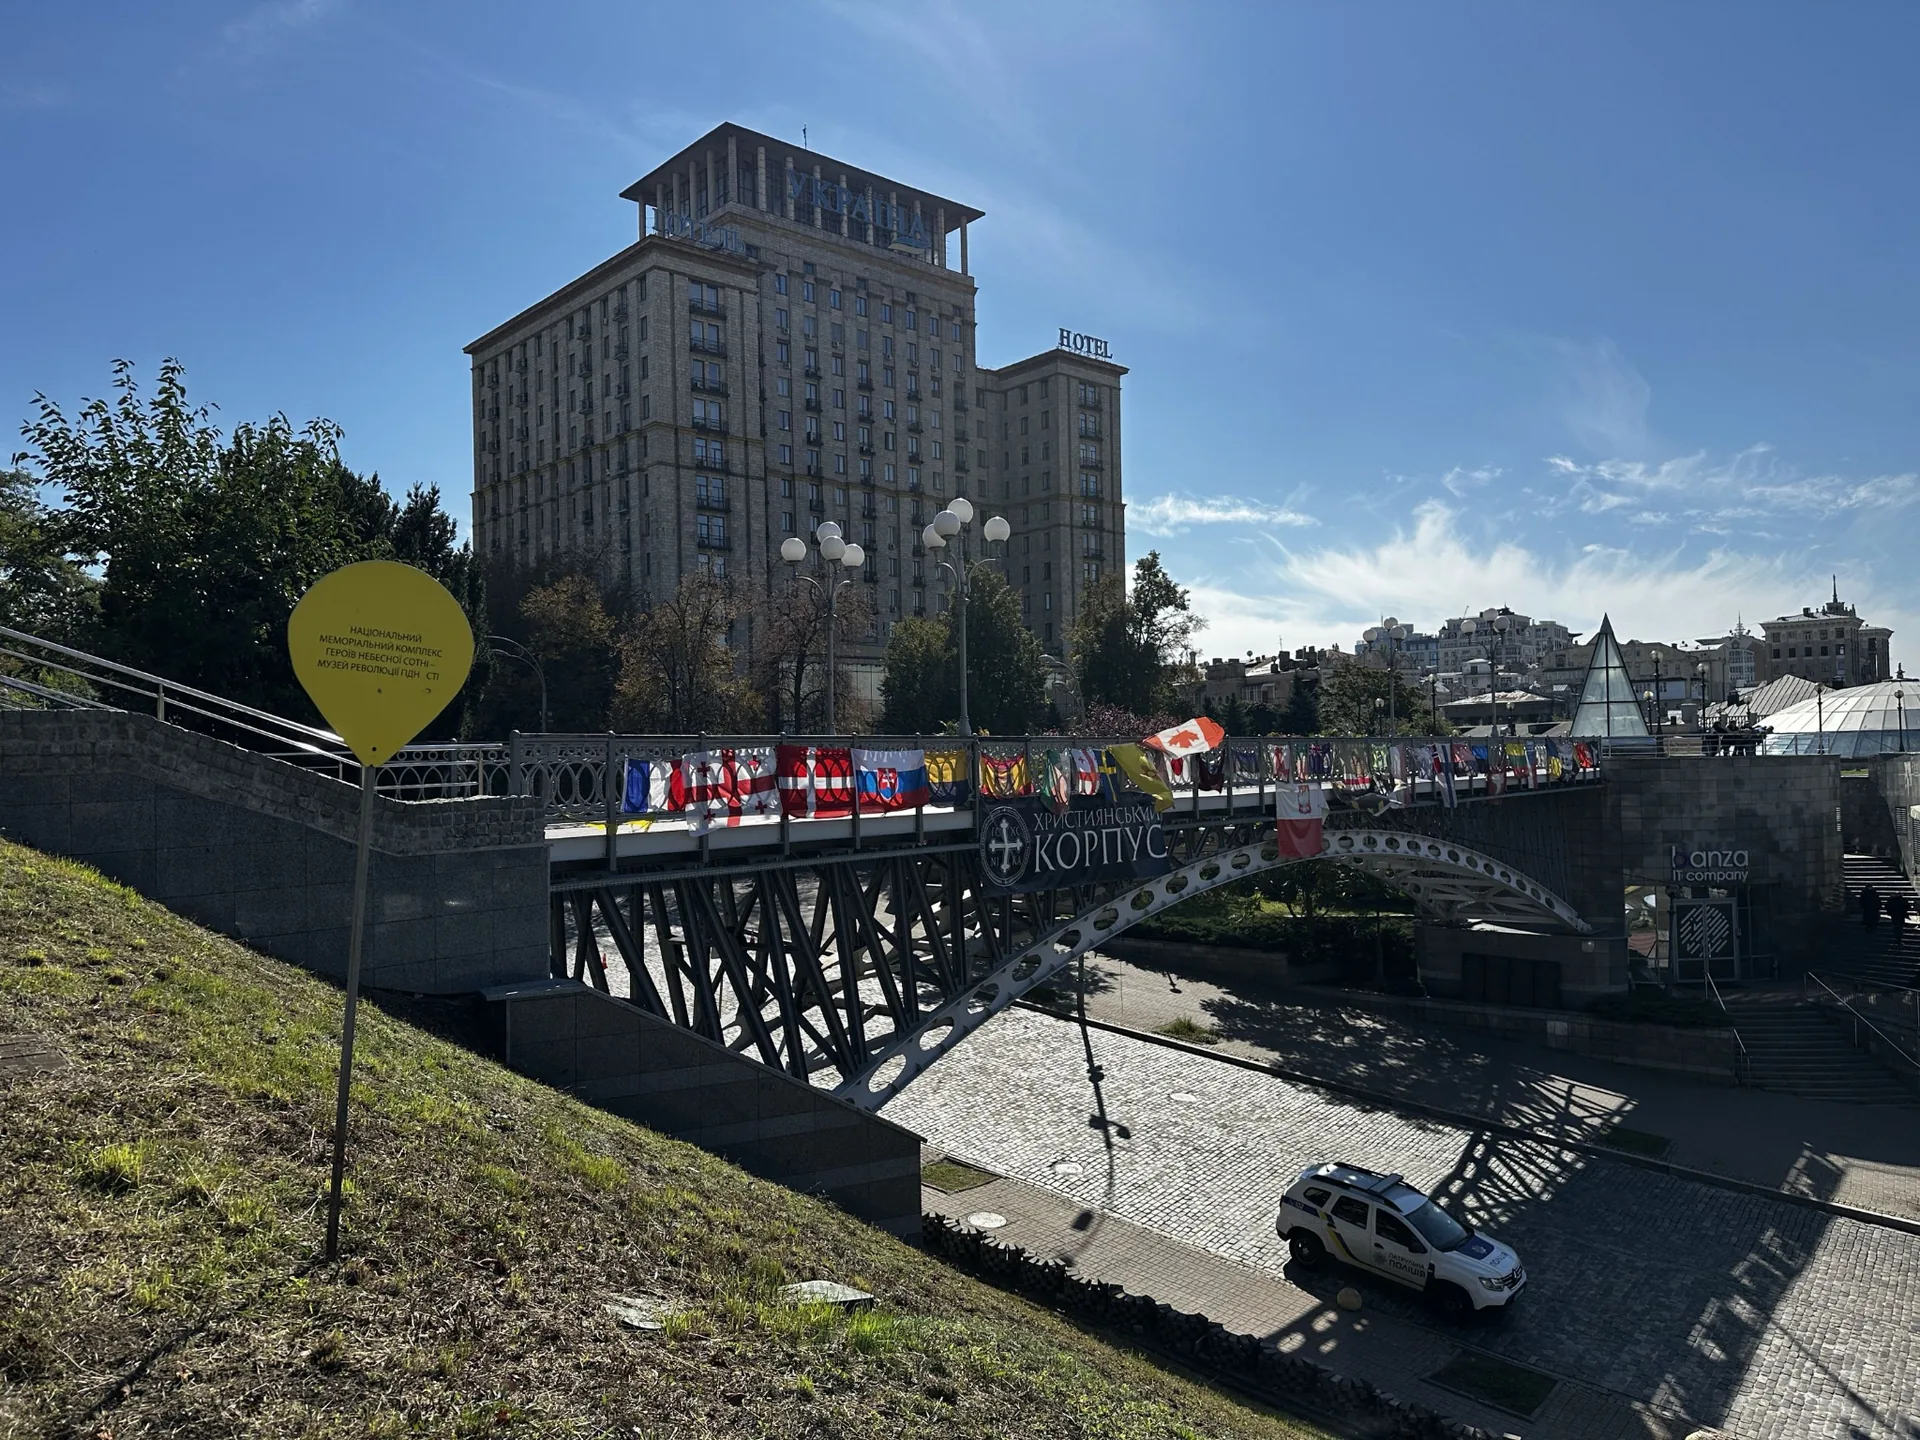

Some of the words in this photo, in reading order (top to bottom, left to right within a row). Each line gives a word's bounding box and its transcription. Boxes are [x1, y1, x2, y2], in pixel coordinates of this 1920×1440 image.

[785, 168, 927, 241] УКРАЇНА
[1058, 327, 1114, 360] HOTEL
[349, 625, 422, 643] НАЦІОНАЛЬНИЙ
[319, 634, 394, 652] МЕМОРІАЛЬНИЙ
[395, 644, 443, 658] КОМПЛЕКС
[317, 659, 349, 670] МУЗЕЙ
[325, 647, 357, 660] ГЕРОЇВ
[358, 651, 402, 664] НЕБЕСНОЇ
[403, 657, 429, 668] СОТНІ
[1034, 824, 1169, 874] КОРПУС
[1671, 845, 1749, 869] banza
[1672, 869, 1682, 882] IT
[1686, 870, 1749, 883] company
[1389, 1259, 1426, 1279] ПОЛІЦІЯ
